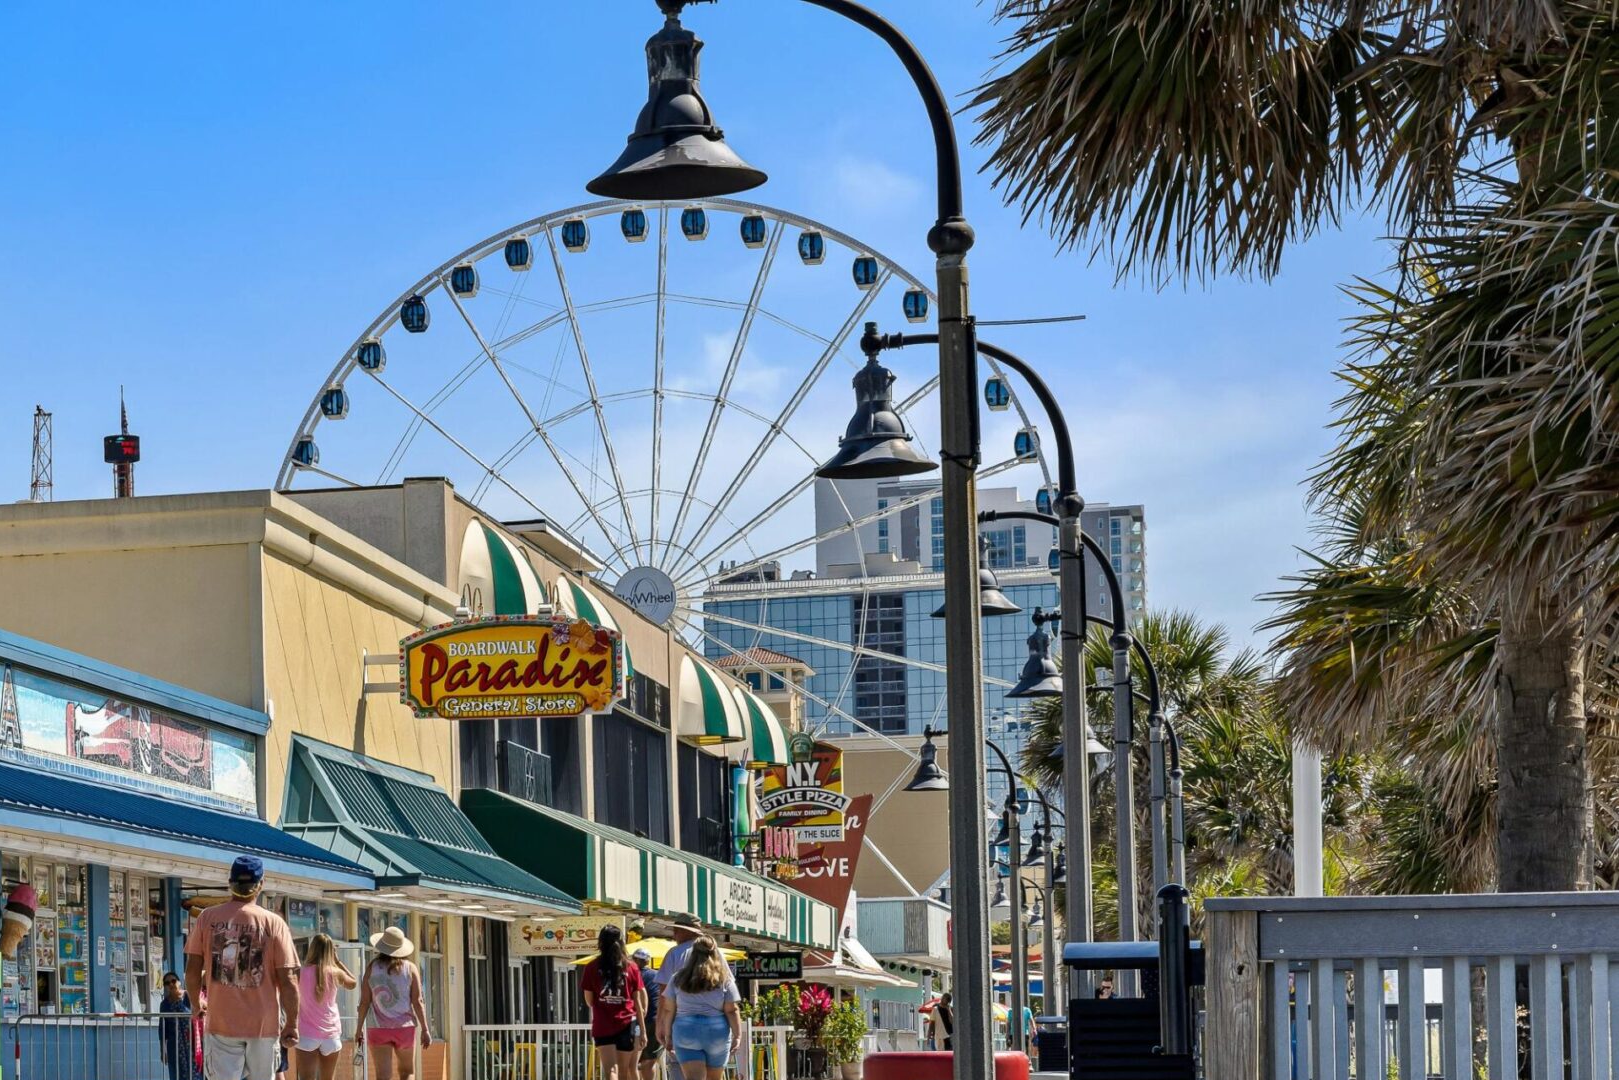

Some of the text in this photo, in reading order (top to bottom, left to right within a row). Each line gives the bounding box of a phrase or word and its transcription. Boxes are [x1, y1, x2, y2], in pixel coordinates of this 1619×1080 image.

[448, 639, 537, 657] BOARDWALK
[420, 632, 608, 707] Paradise
[444, 697, 577, 716] General Store
[786, 761, 822, 787] N.Y.
[761, 790, 843, 811] STYLE PIZZA
[804, 830, 818, 839] THE
[820, 829, 840, 838] SLICE
